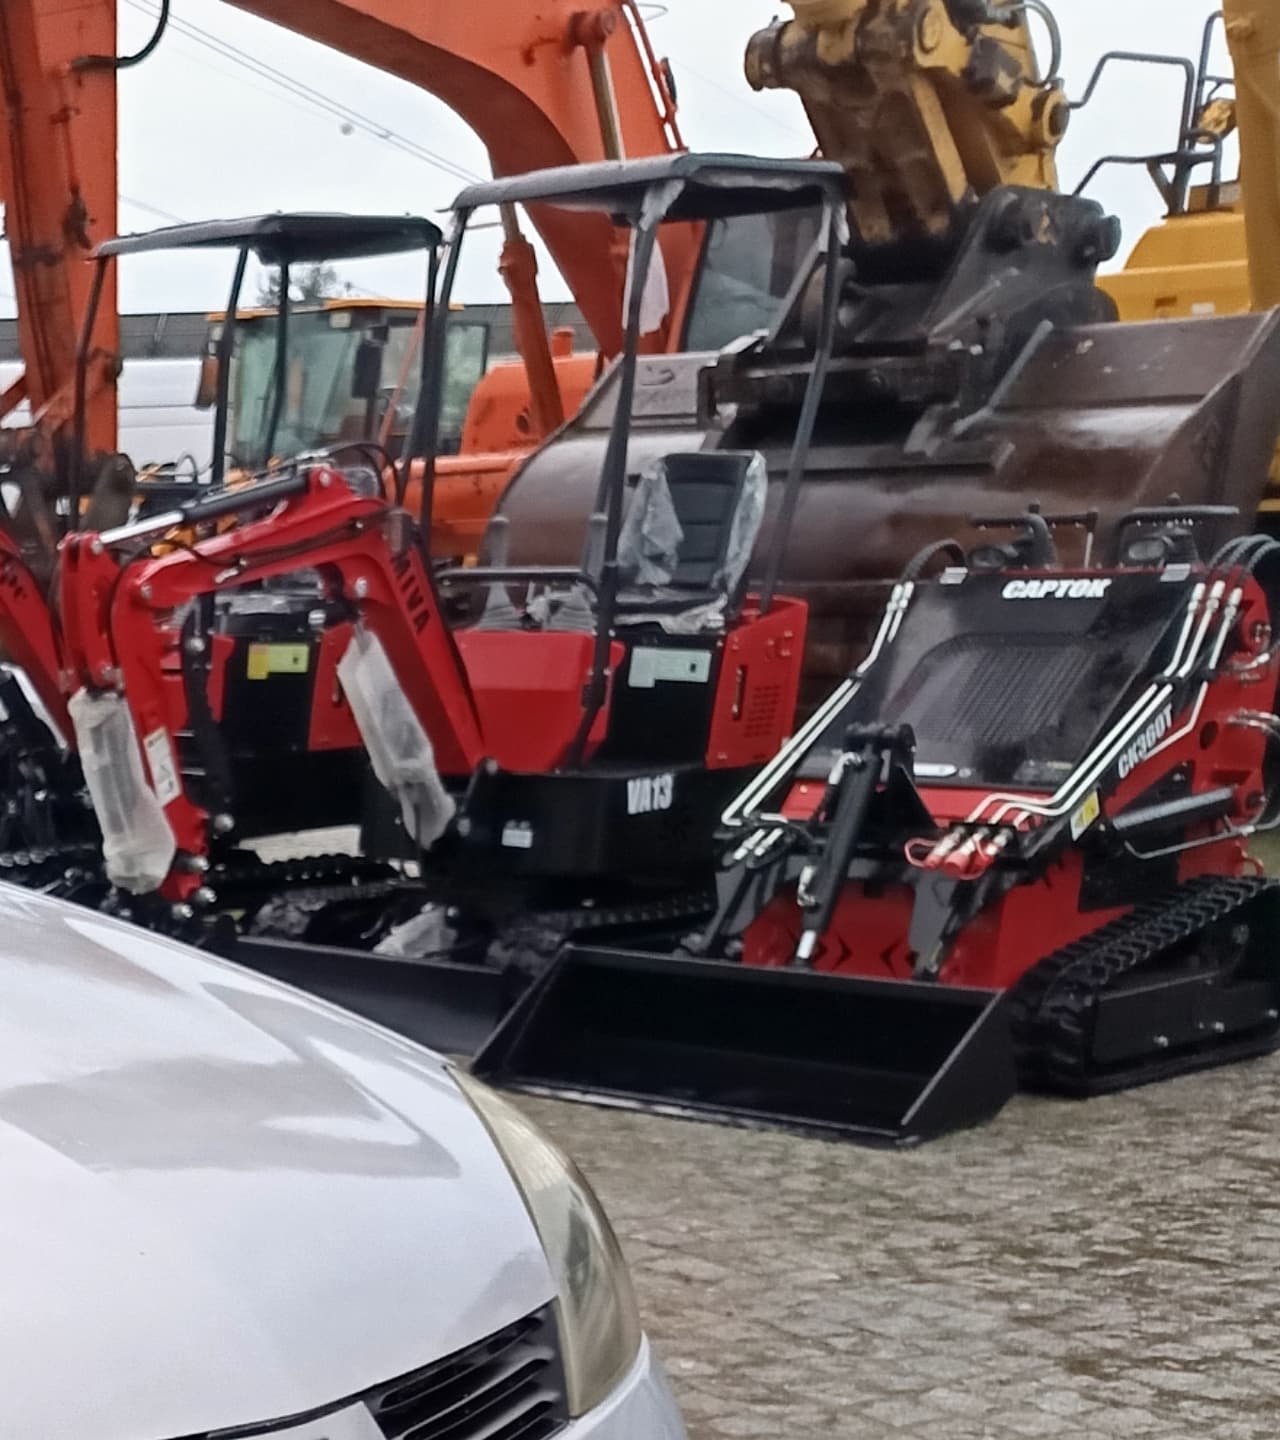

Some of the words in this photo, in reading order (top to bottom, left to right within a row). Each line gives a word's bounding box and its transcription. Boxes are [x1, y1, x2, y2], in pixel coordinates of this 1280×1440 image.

[1002, 578, 1112, 599] CAPTOK
[1118, 703, 1172, 779] CK360T
[627, 773, 672, 815] VA13
